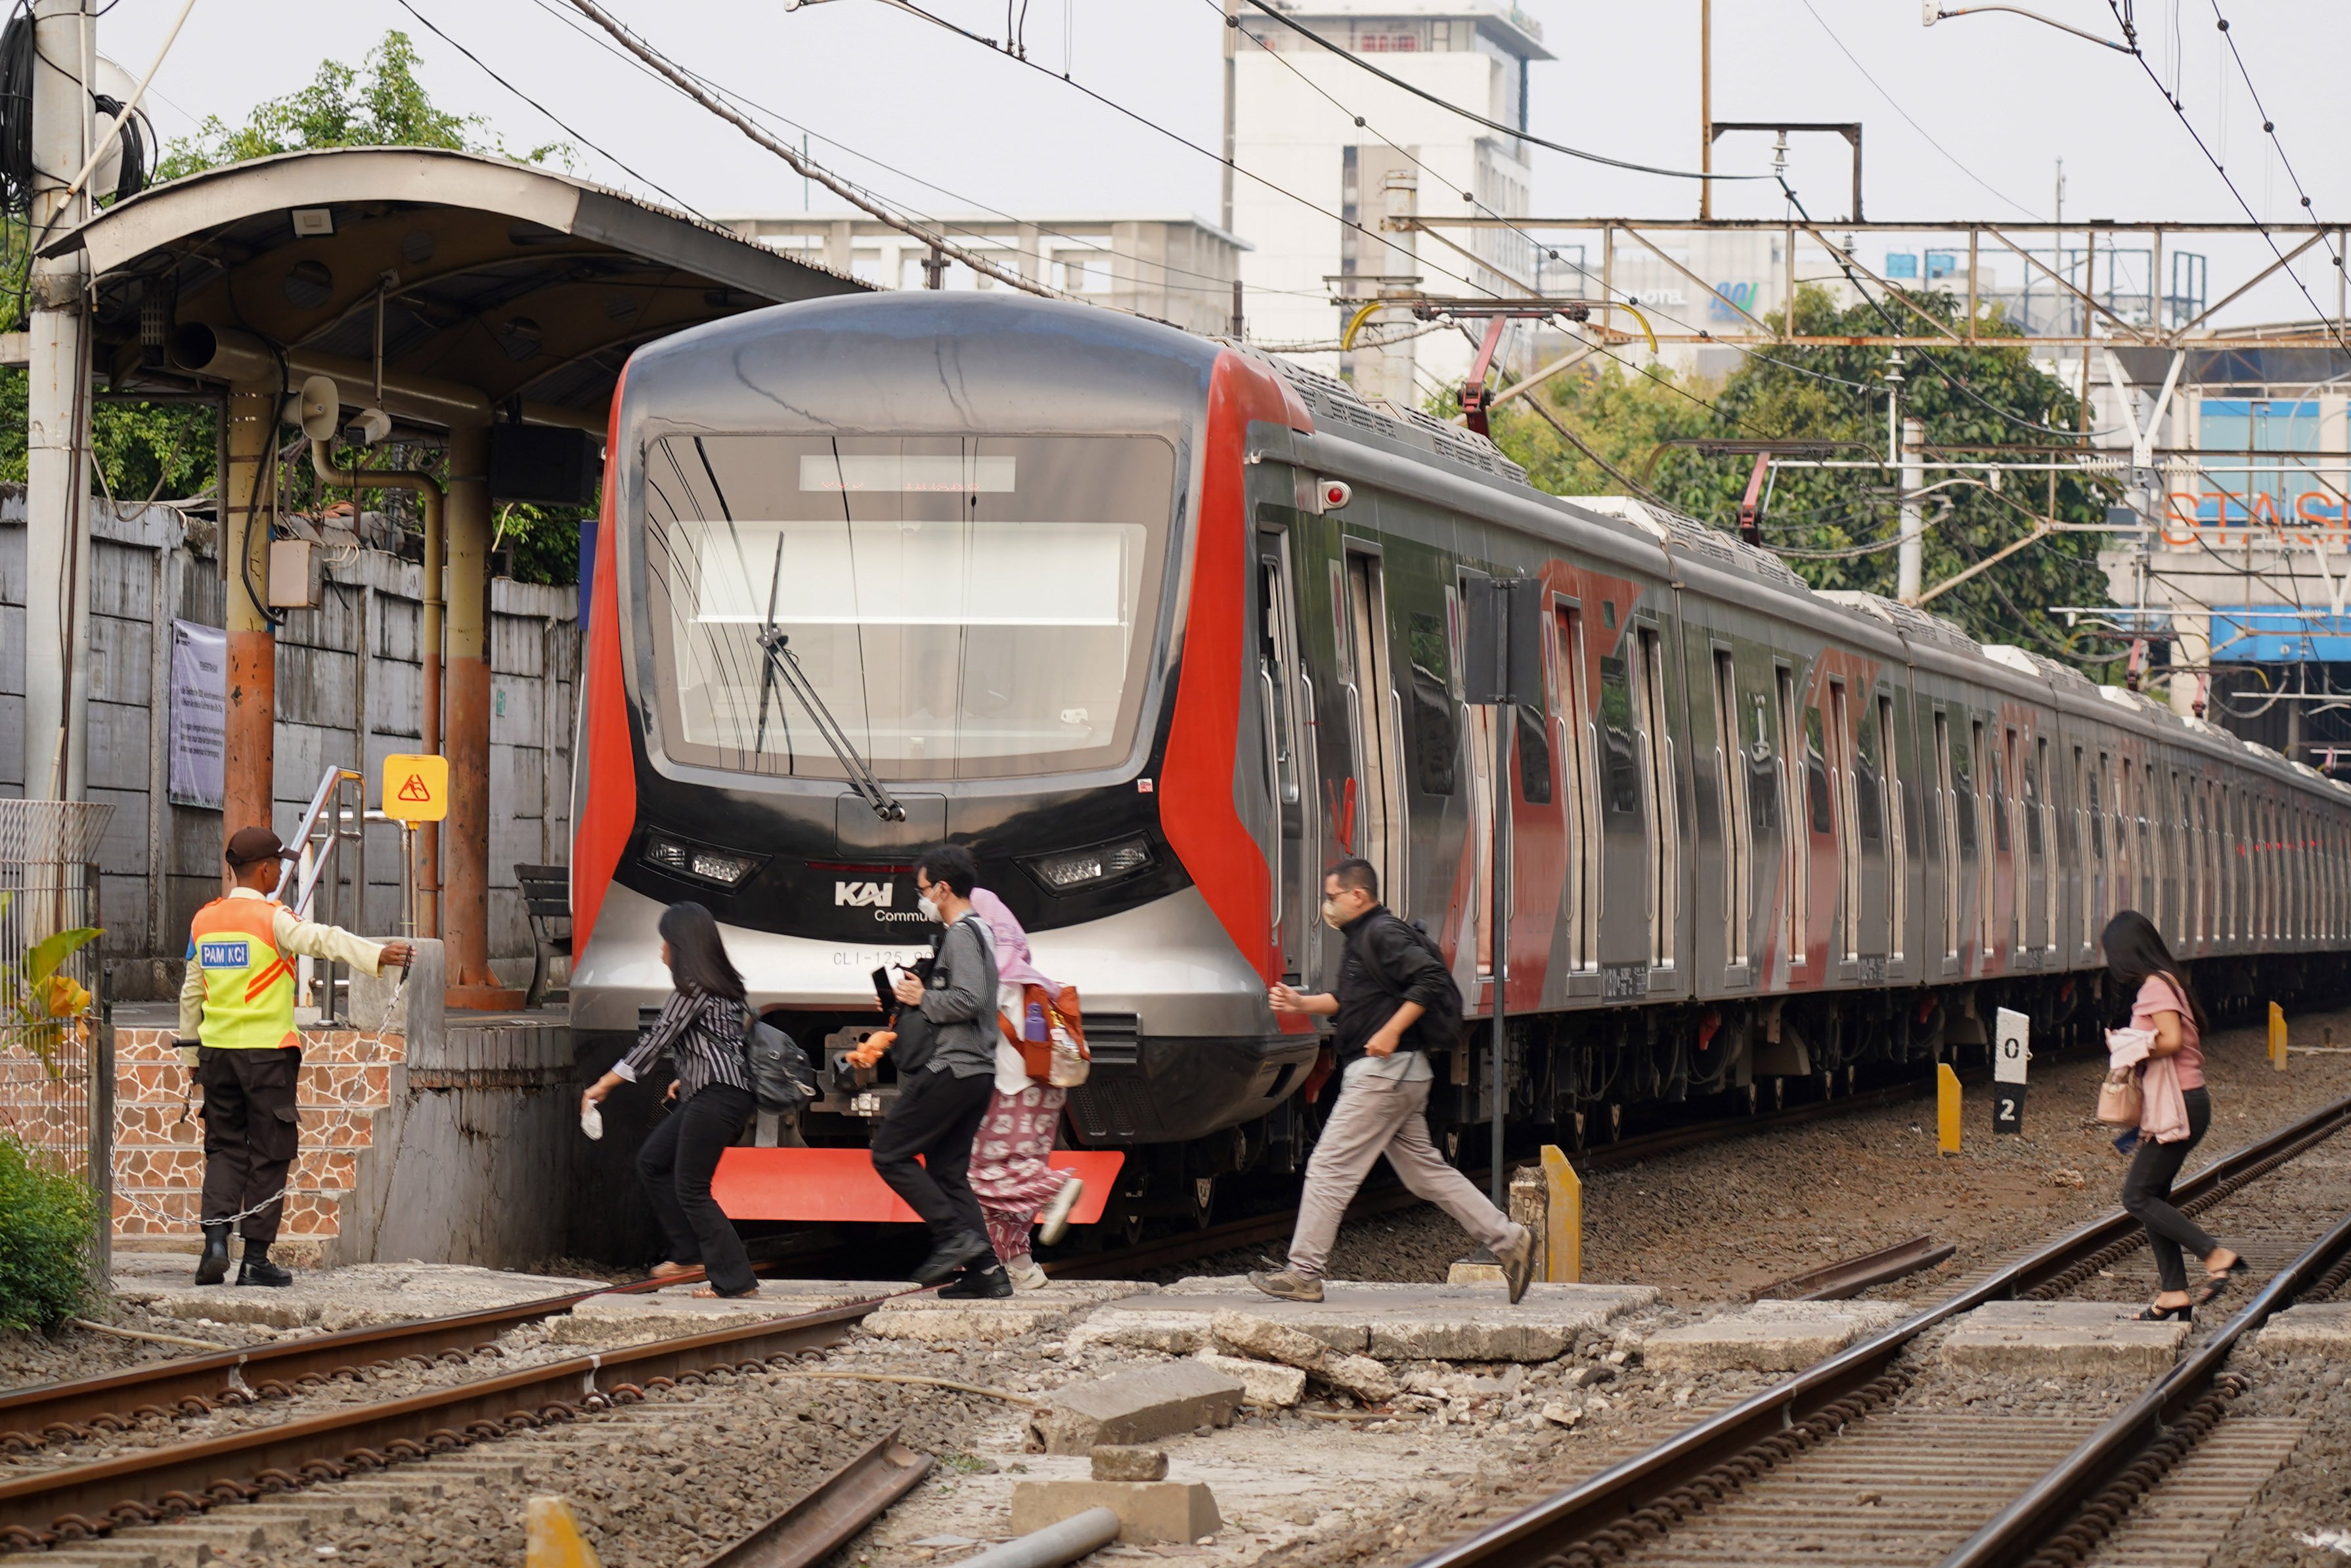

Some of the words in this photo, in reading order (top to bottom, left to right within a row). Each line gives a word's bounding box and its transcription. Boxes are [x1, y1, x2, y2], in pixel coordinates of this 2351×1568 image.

[835, 881, 893, 907] KAI
[874, 909, 932, 922] Commu
[204, 947, 225, 963] PAM
[228, 946, 245, 963] KCI
[2000, 1099, 2015, 1121] 2
